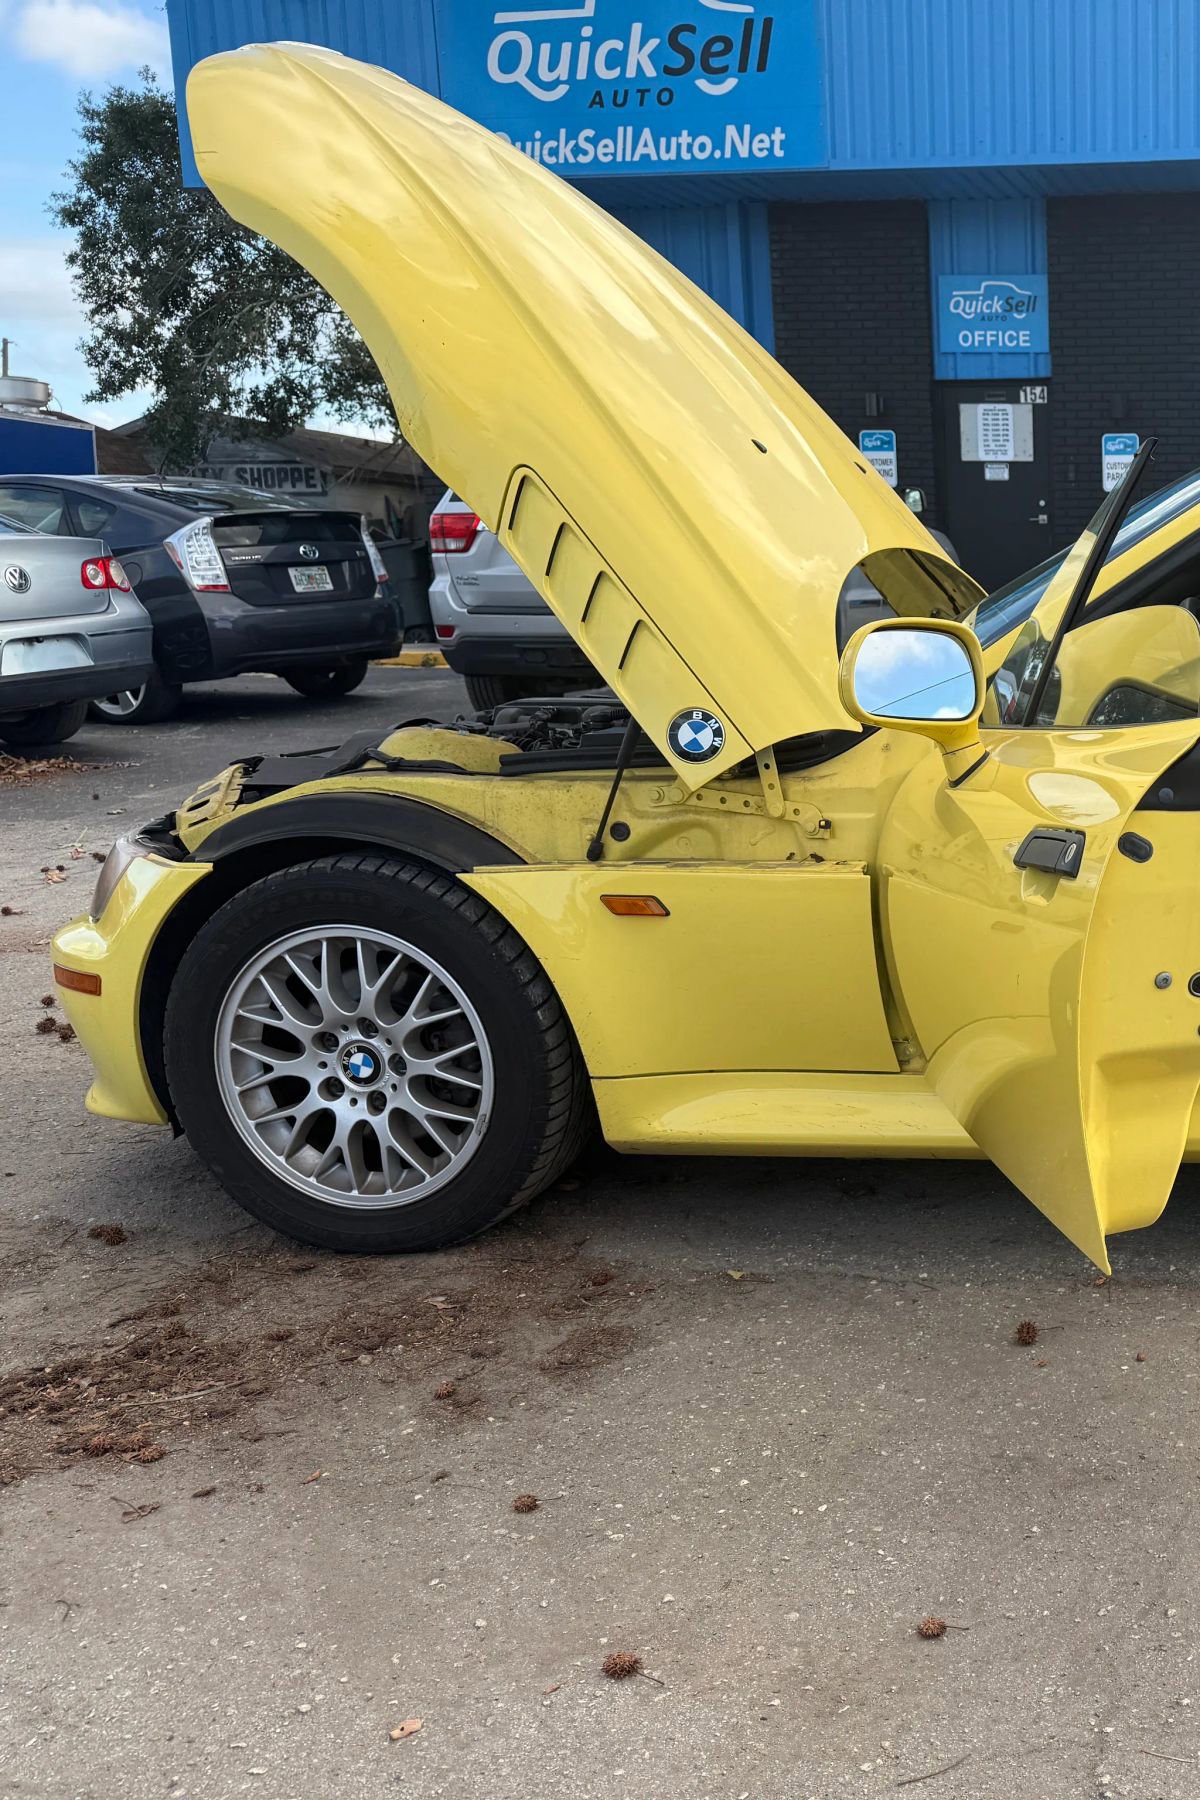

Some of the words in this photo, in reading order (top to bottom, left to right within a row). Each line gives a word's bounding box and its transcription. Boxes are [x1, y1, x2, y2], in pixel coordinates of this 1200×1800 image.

[487, 17, 774, 102] QuickSell
[588, 87, 675, 109] AUTO
[496, 124, 786, 165] uickSellAuto.Net
[949, 295, 1038, 319] QuickSell
[958, 330, 1032, 347] OFFICE
[1021, 386, 1046, 402] 154
[235, 466, 318, 489] SHOPPE
